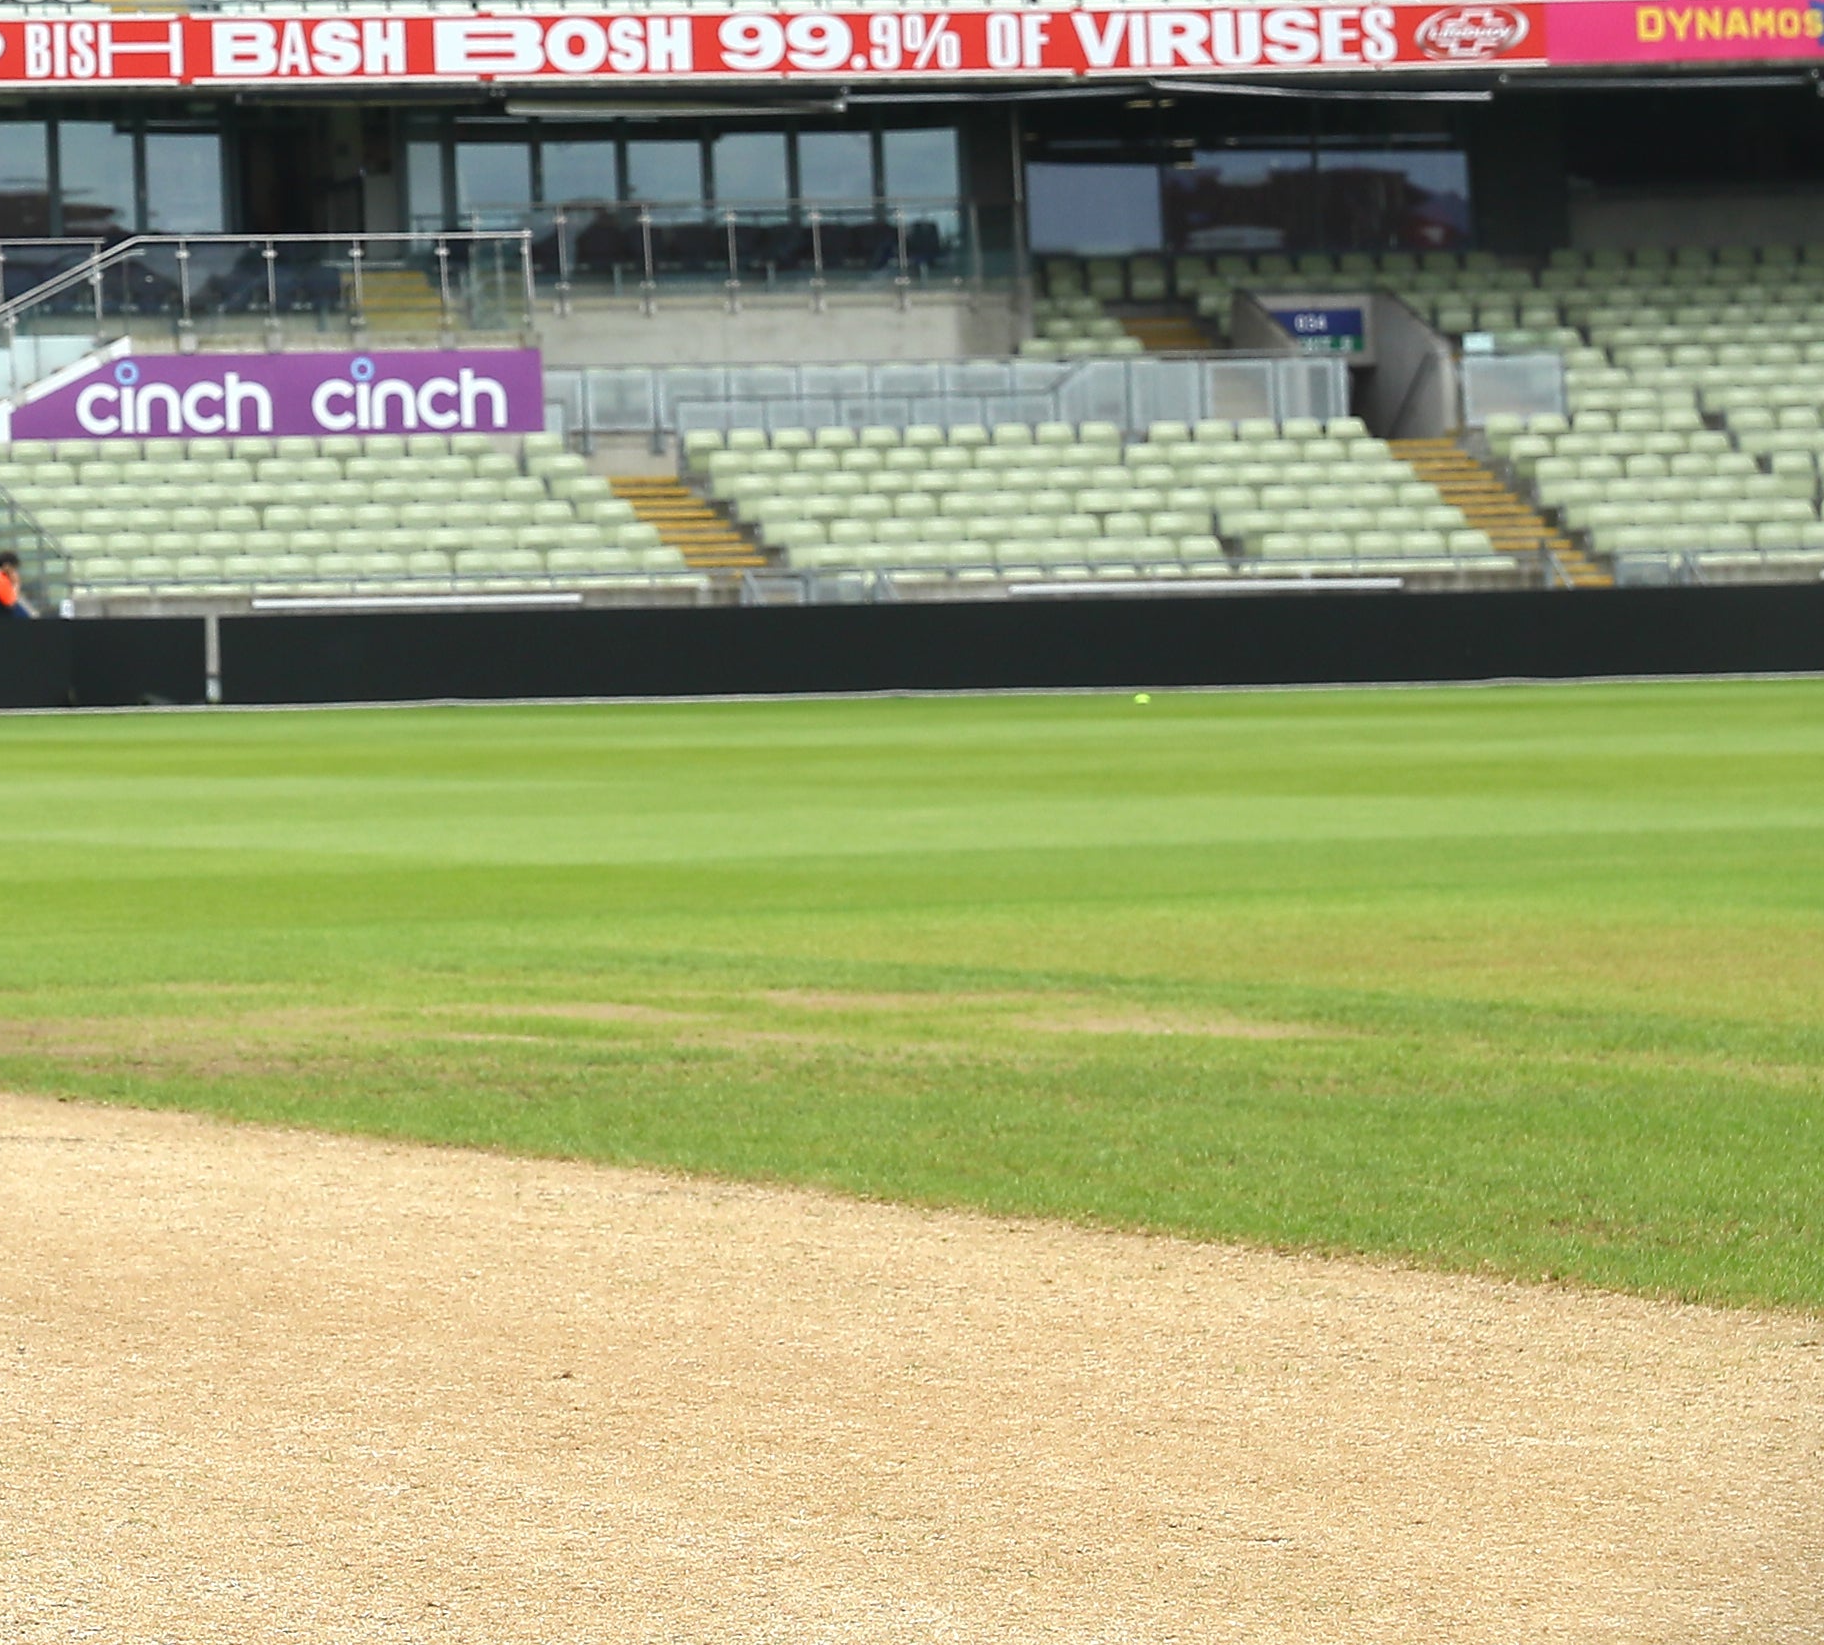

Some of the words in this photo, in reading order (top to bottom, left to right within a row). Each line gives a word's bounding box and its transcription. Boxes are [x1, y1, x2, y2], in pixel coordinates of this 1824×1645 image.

[24, 22, 184, 78] BISH
[212, 19, 407, 74] BASH
[433, 19, 693, 73] BOSH
[718, 12, 960, 71] 99.9%
[986, 11, 1048, 66] OF
[1074, 4, 1397, 66] VIRUSES
[1637, 7, 1824, 41] DYNAMOS
[75, 360, 273, 434] cinch
[311, 356, 508, 430] cinch
